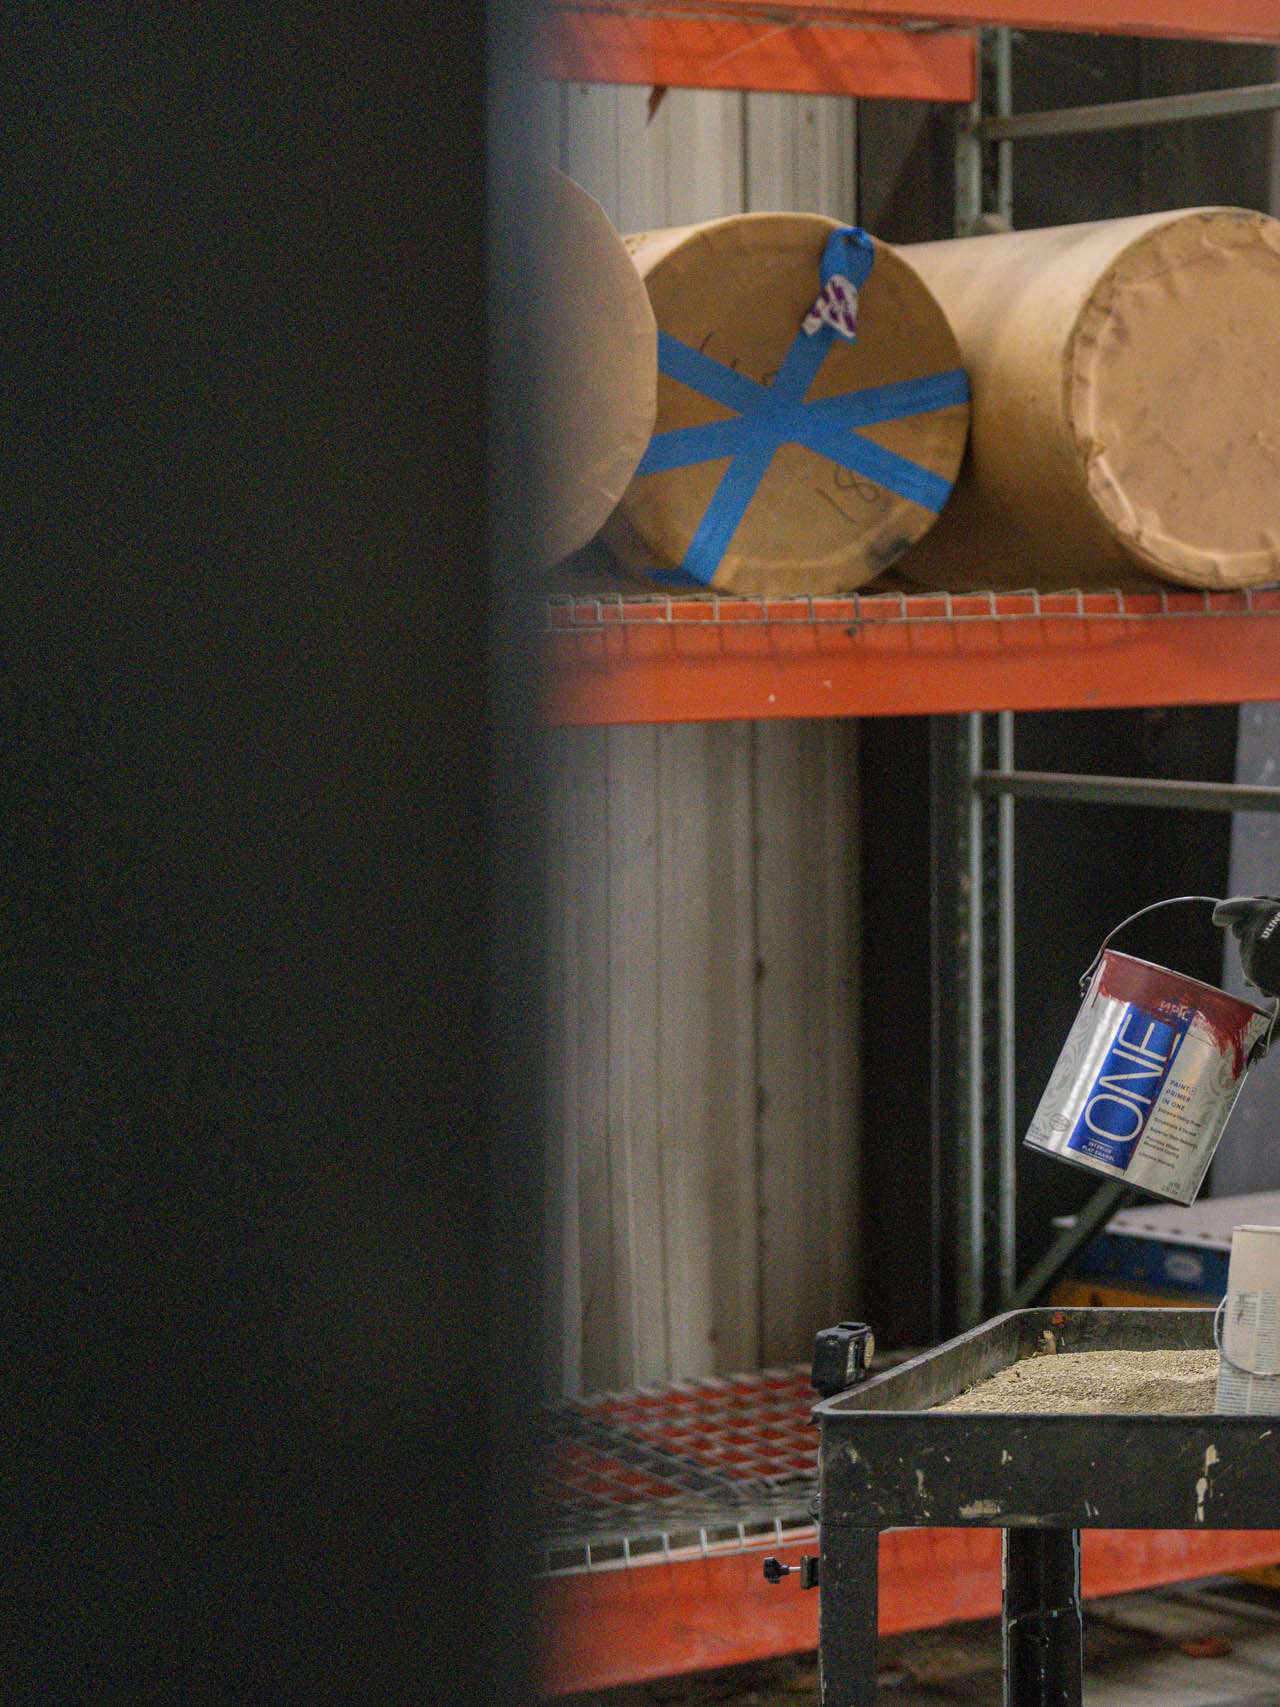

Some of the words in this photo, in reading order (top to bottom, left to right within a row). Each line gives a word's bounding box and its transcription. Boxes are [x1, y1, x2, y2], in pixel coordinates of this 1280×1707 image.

[1085, 1013, 1182, 1143] ONE
[1165, 1089, 1191, 1102] PRIMER
[1170, 1100, 1185, 1111] ONE
